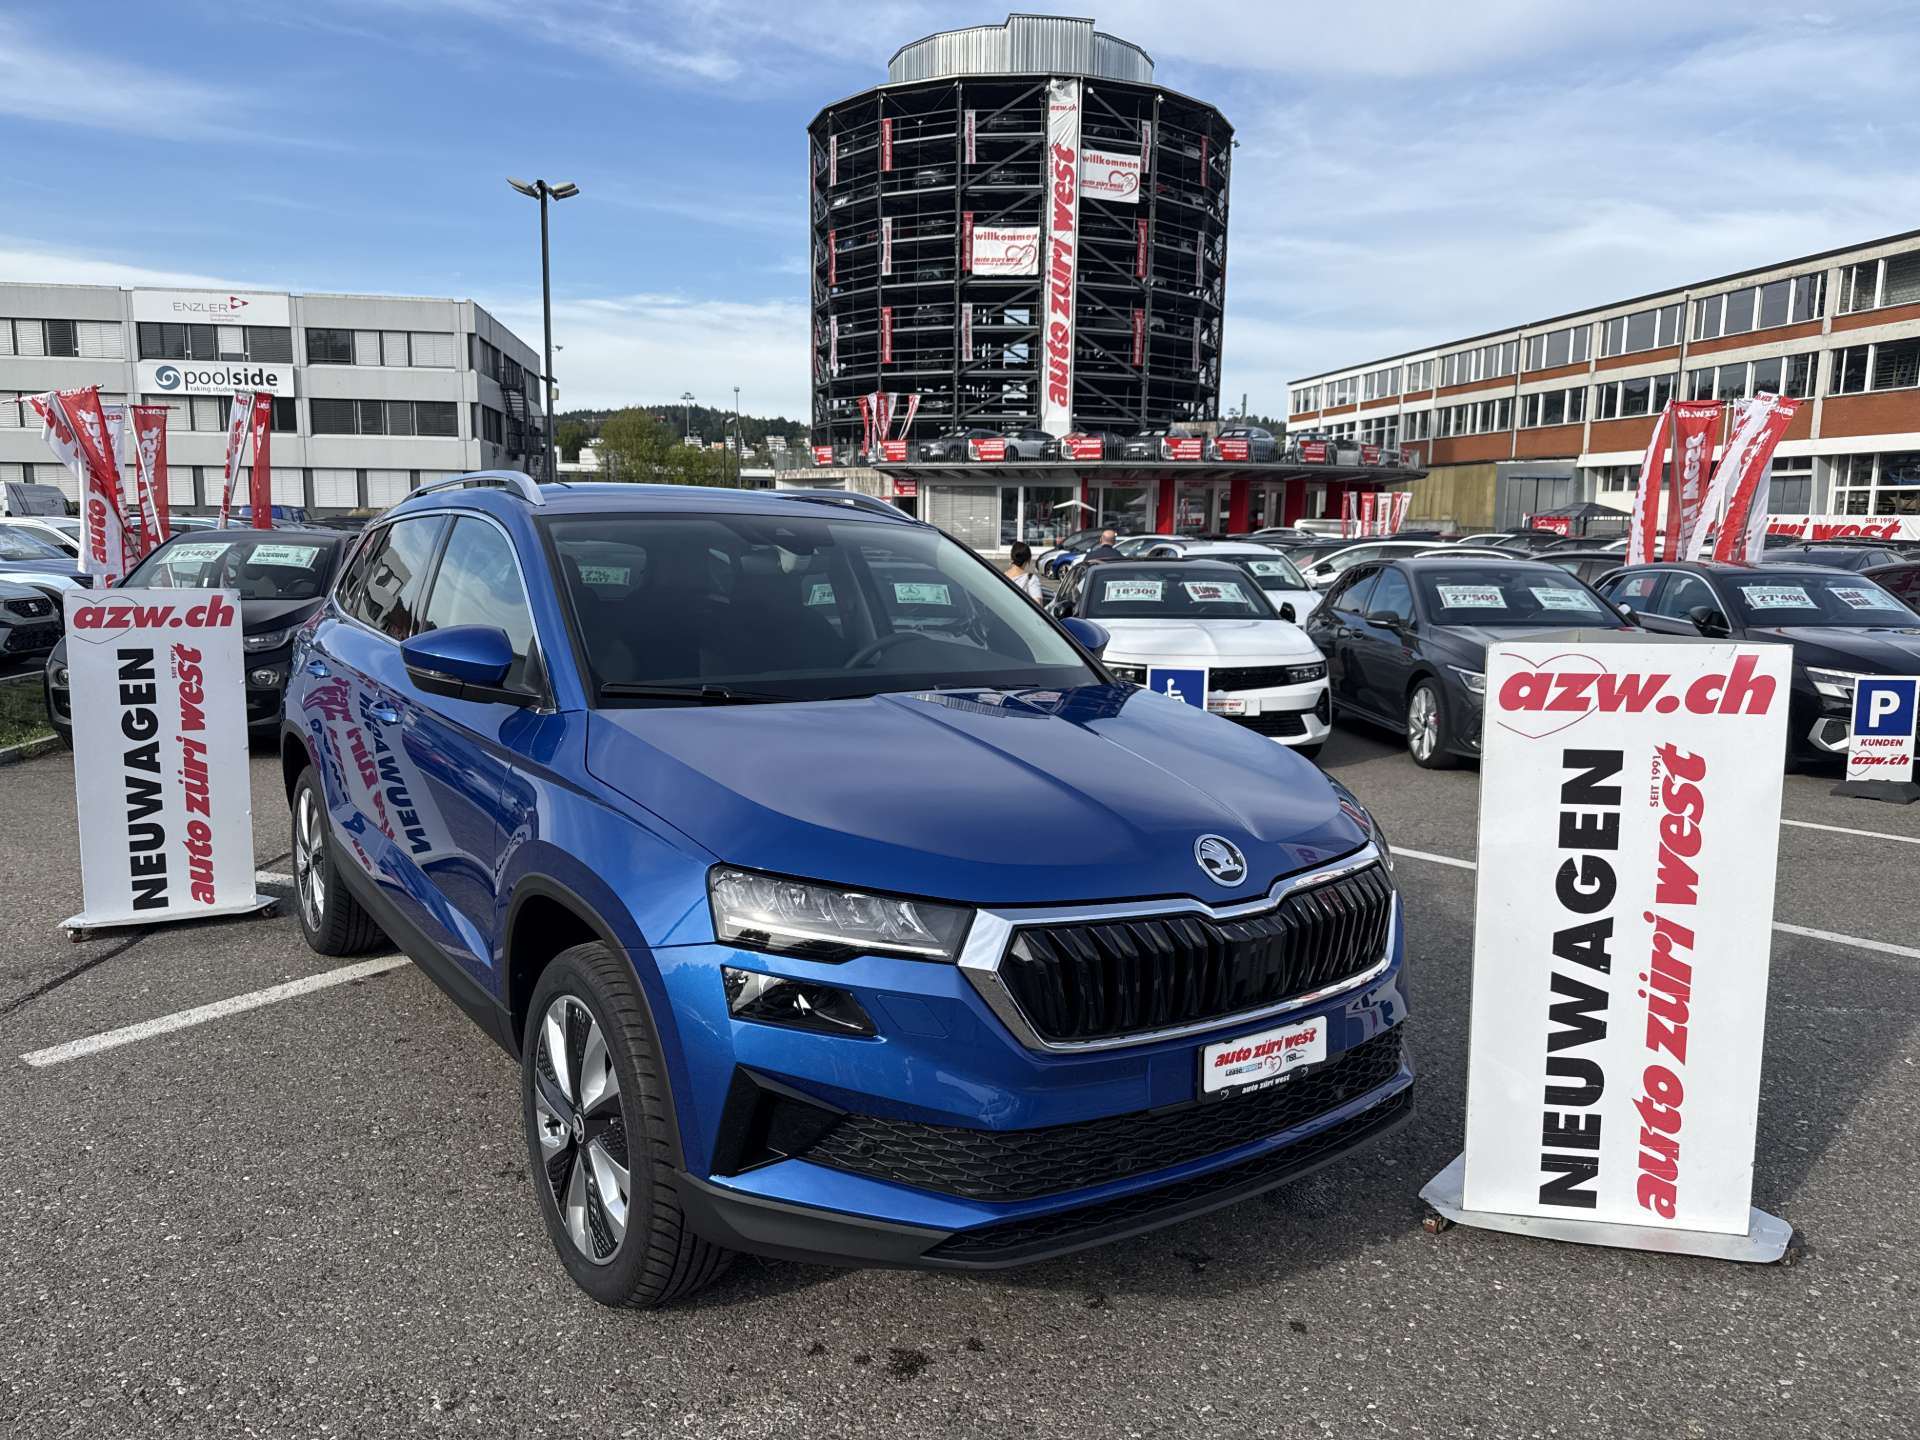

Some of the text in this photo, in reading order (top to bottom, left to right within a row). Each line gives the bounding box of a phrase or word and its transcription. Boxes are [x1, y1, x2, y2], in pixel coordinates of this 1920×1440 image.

[1050, 102, 1077, 112] azw.ch
[1081, 154, 1139, 169] willkommen
[1047, 143, 1076, 408] auto züri west
[172, 302, 228, 313] ENZLER
[184, 367, 278, 391] poolside
[1115, 587, 1157, 595] 18'300
[1451, 593, 1499, 601] 27'500
[1759, 594, 1806, 602] 27'400
[73, 595, 235, 629] azw.ch
[1498, 654, 1777, 716] azw.ch
[1868, 690, 1901, 728] P
[1860, 739, 1904, 747] KUNDEN
[170, 643, 215, 905] auto züri west
[1851, 754, 1910, 766] azw.ch
[117, 648, 169, 911] NEUWAGEN
[1649, 754, 1661, 808] SEIT 1991
[1538, 748, 1625, 1209] NEUWAGEN
[1631, 742, 1708, 1221] auto züri west
[1214, 1028, 1317, 1068] auto züri west
[1241, 1084, 1258, 1094] auto
[1275, 1074, 1290, 1084] west
